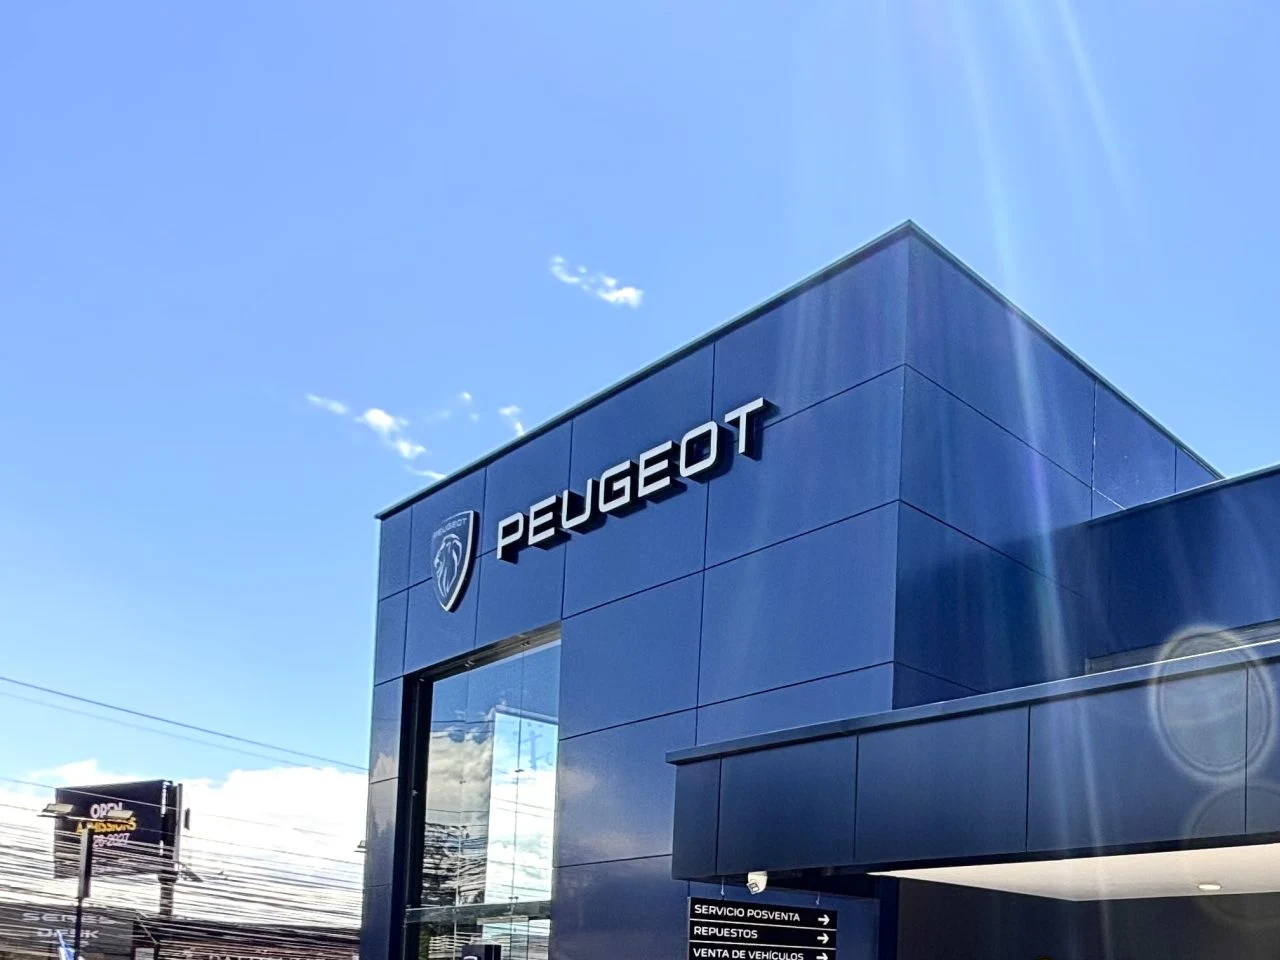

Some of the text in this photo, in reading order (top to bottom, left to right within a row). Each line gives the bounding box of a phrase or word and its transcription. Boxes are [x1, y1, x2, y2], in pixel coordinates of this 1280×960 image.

[497, 397, 765, 560] PEUGEOT
[433, 517, 467, 538] PEUGEOT
[694, 904, 800, 922] SERVICIO POSVENTA
[693, 926, 758, 939] REPUESTOS
[693, 947, 729, 959] VENTA
[731, 949, 746, 960] DE
